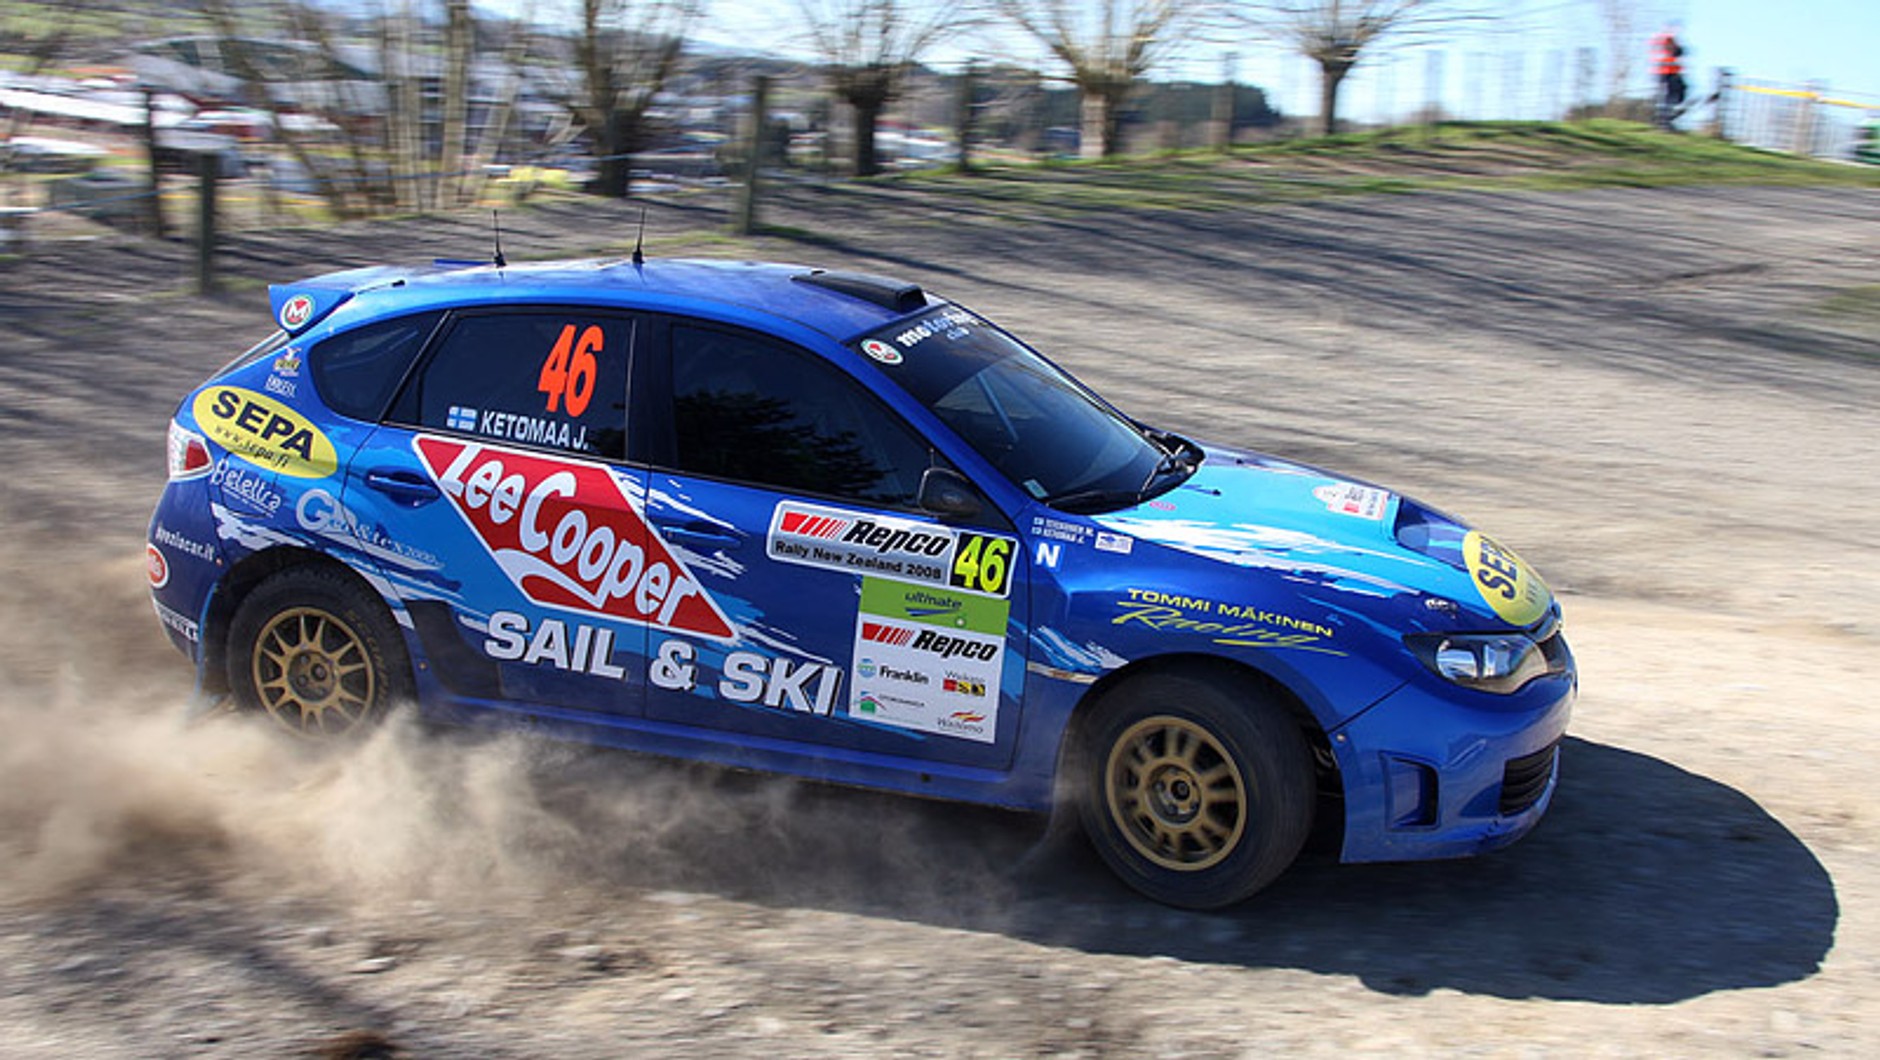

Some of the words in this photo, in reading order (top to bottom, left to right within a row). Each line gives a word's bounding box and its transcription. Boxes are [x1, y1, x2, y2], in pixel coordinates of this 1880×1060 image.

[538, 324, 604, 417] 46
[212, 390, 314, 462] SEPA
[479, 410, 570, 447] KETOMAA
[573, 426, 589, 450] J.
[438, 446, 526, 524] Lee
[519, 471, 700, 626] Cooper
[843, 520, 951, 556] Repco
[1035, 542, 1061, 568] N
[775, 541, 809, 558] Rally
[813, 549, 848, 563] New
[849, 552, 901, 573] Zealand
[907, 563, 942, 579] 2008
[954, 535, 1010, 593] 46
[905, 592, 962, 609] ultimate
[1128, 588, 1211, 613] TOMMI
[1218, 604, 1333, 637] MÄKINEN
[484, 611, 629, 681] SAIL
[649, 640, 699, 693] &
[718, 650, 843, 716] SKI
[912, 629, 998, 661] Repco
[880, 665, 929, 684] Franklin
